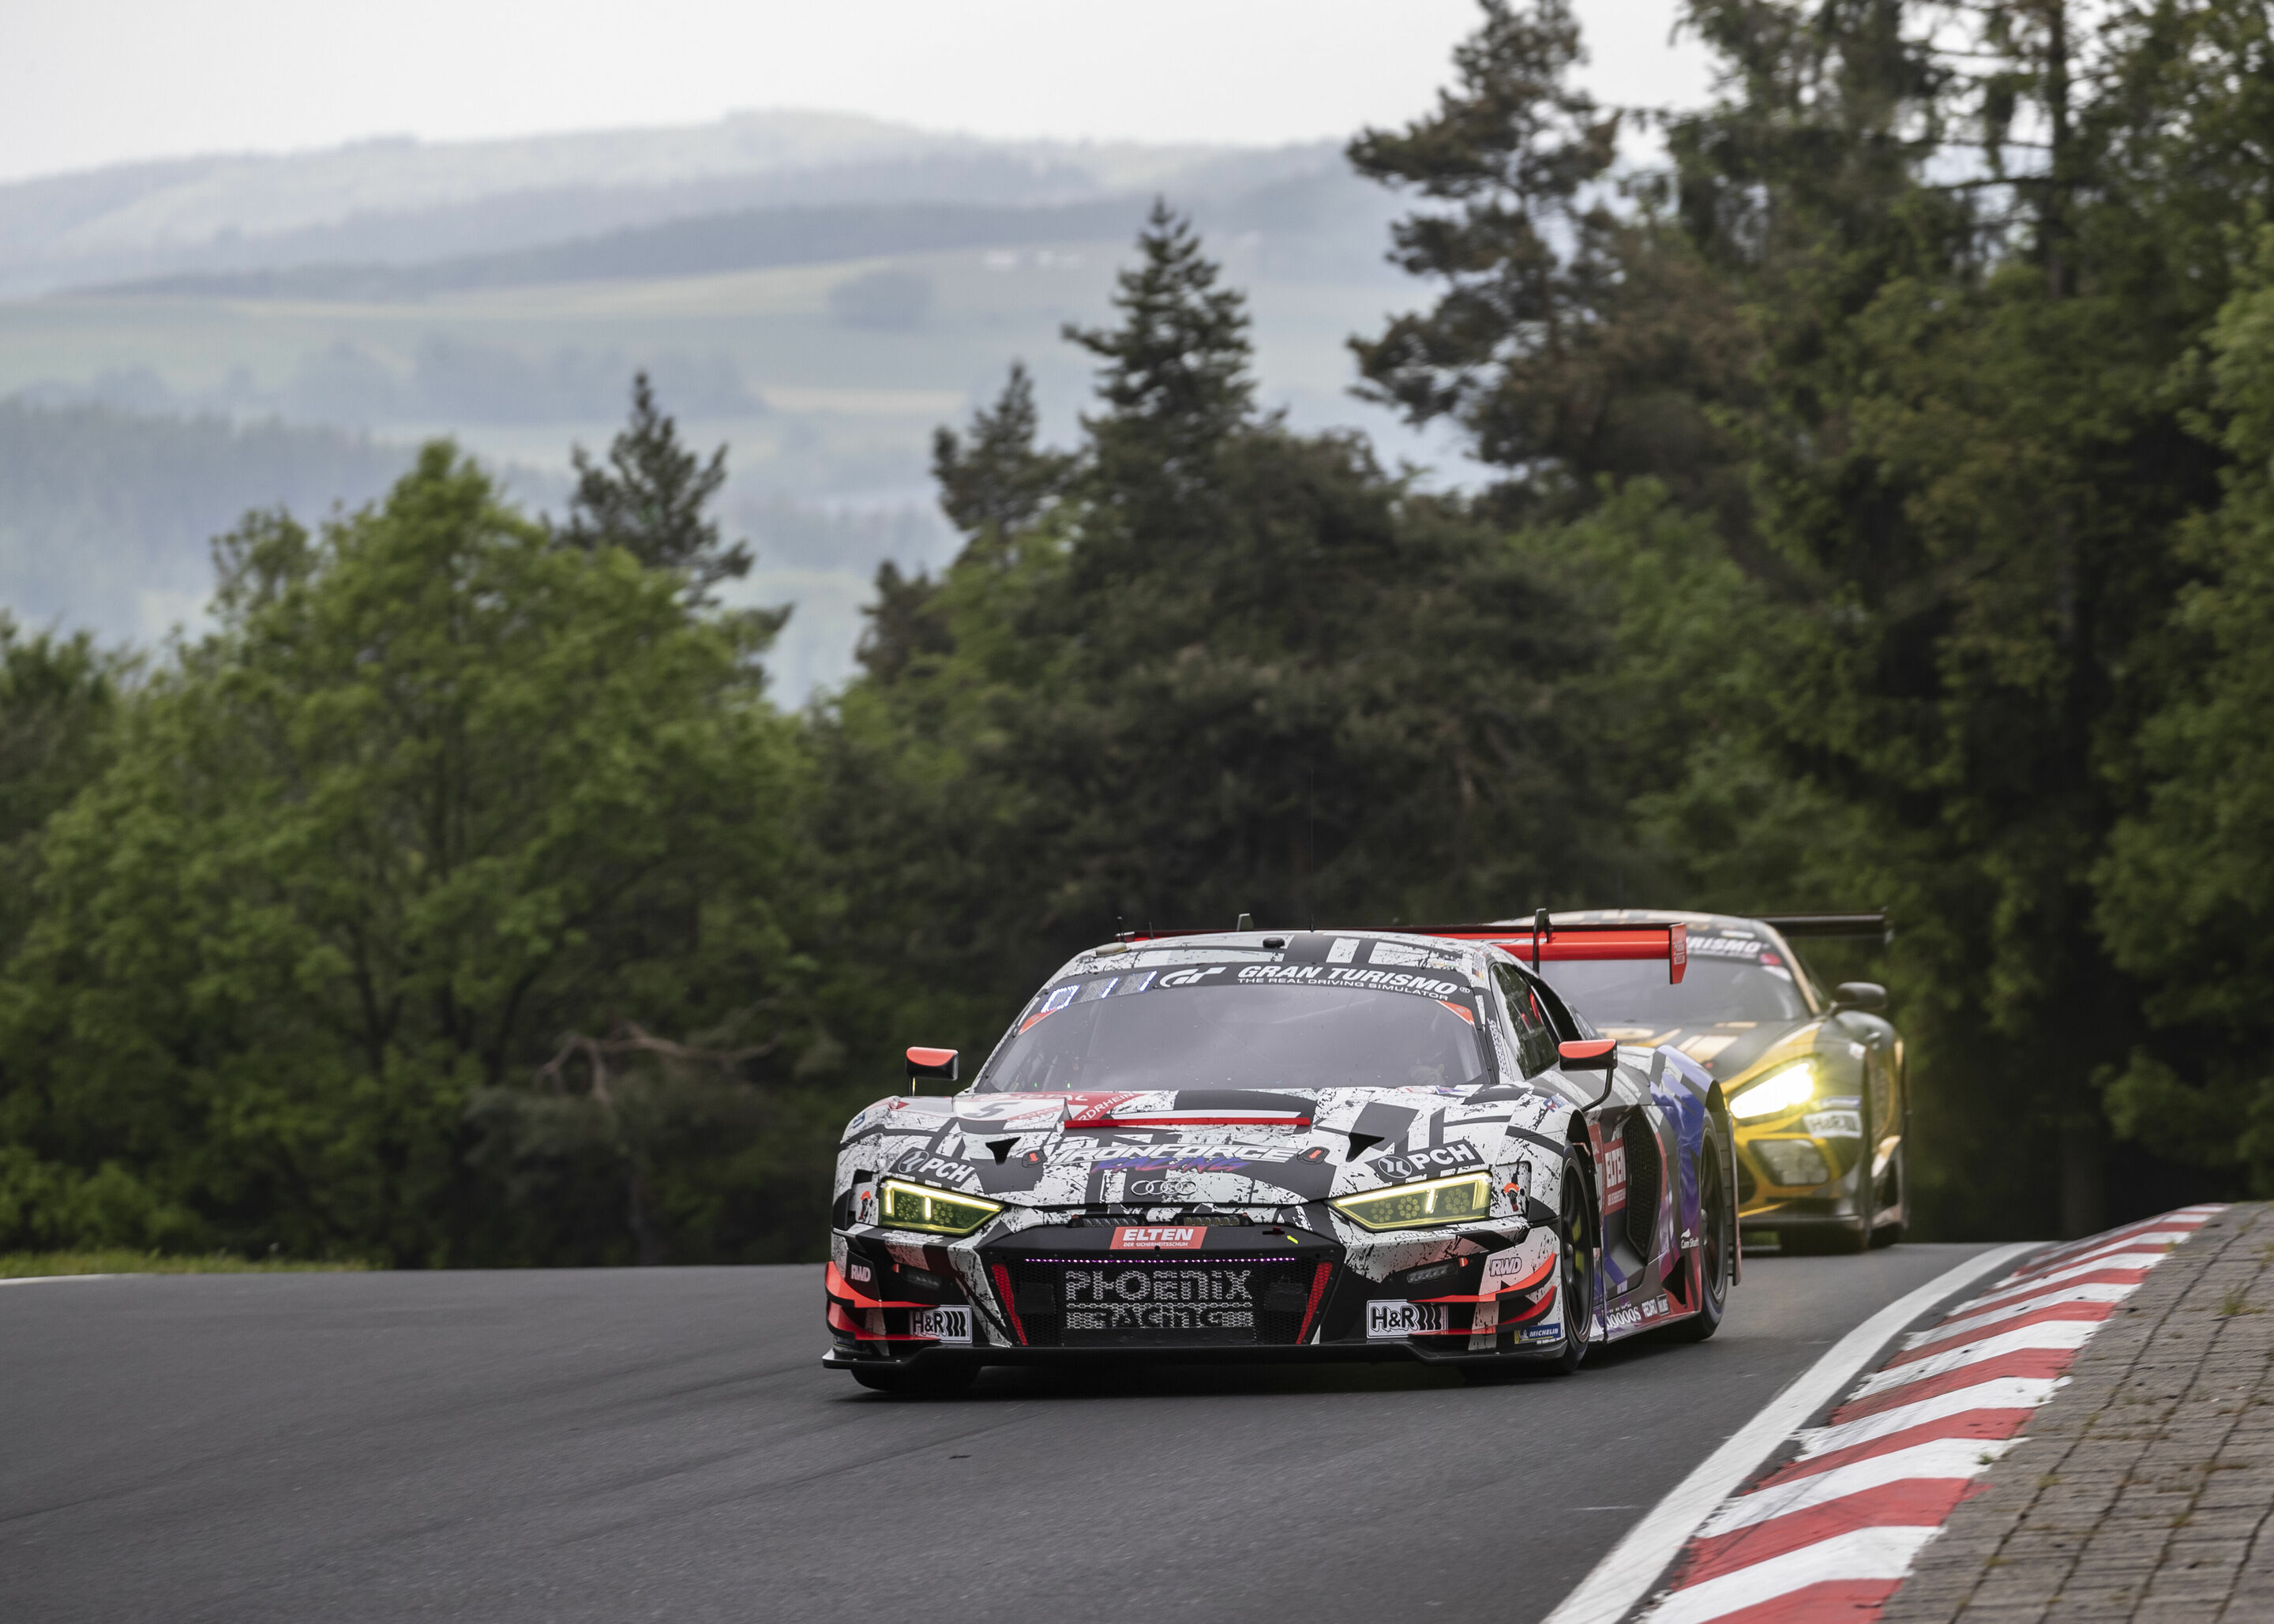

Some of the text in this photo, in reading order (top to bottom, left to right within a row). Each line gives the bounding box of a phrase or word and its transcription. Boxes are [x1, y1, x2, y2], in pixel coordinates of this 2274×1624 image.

[1237, 966, 1458, 995] GRAN TURISMO
[1308, 978, 1364, 988] DRIVING
[1368, 983, 1449, 1001] SIMULATOR
[1051, 1143, 1302, 1164] IRONFORCE
[1407, 1144, 1475, 1170] PCH
[918, 1157, 976, 1182] PCH
[1123, 1228, 1194, 1241] ELTEN
[850, 1264, 872, 1283] RWD
[1490, 1257, 1522, 1277] RWD
[913, 1311, 946, 1334] H&R
[1372, 1305, 1417, 1331] H&R
[1529, 1328, 1559, 1337] MICHELIN
